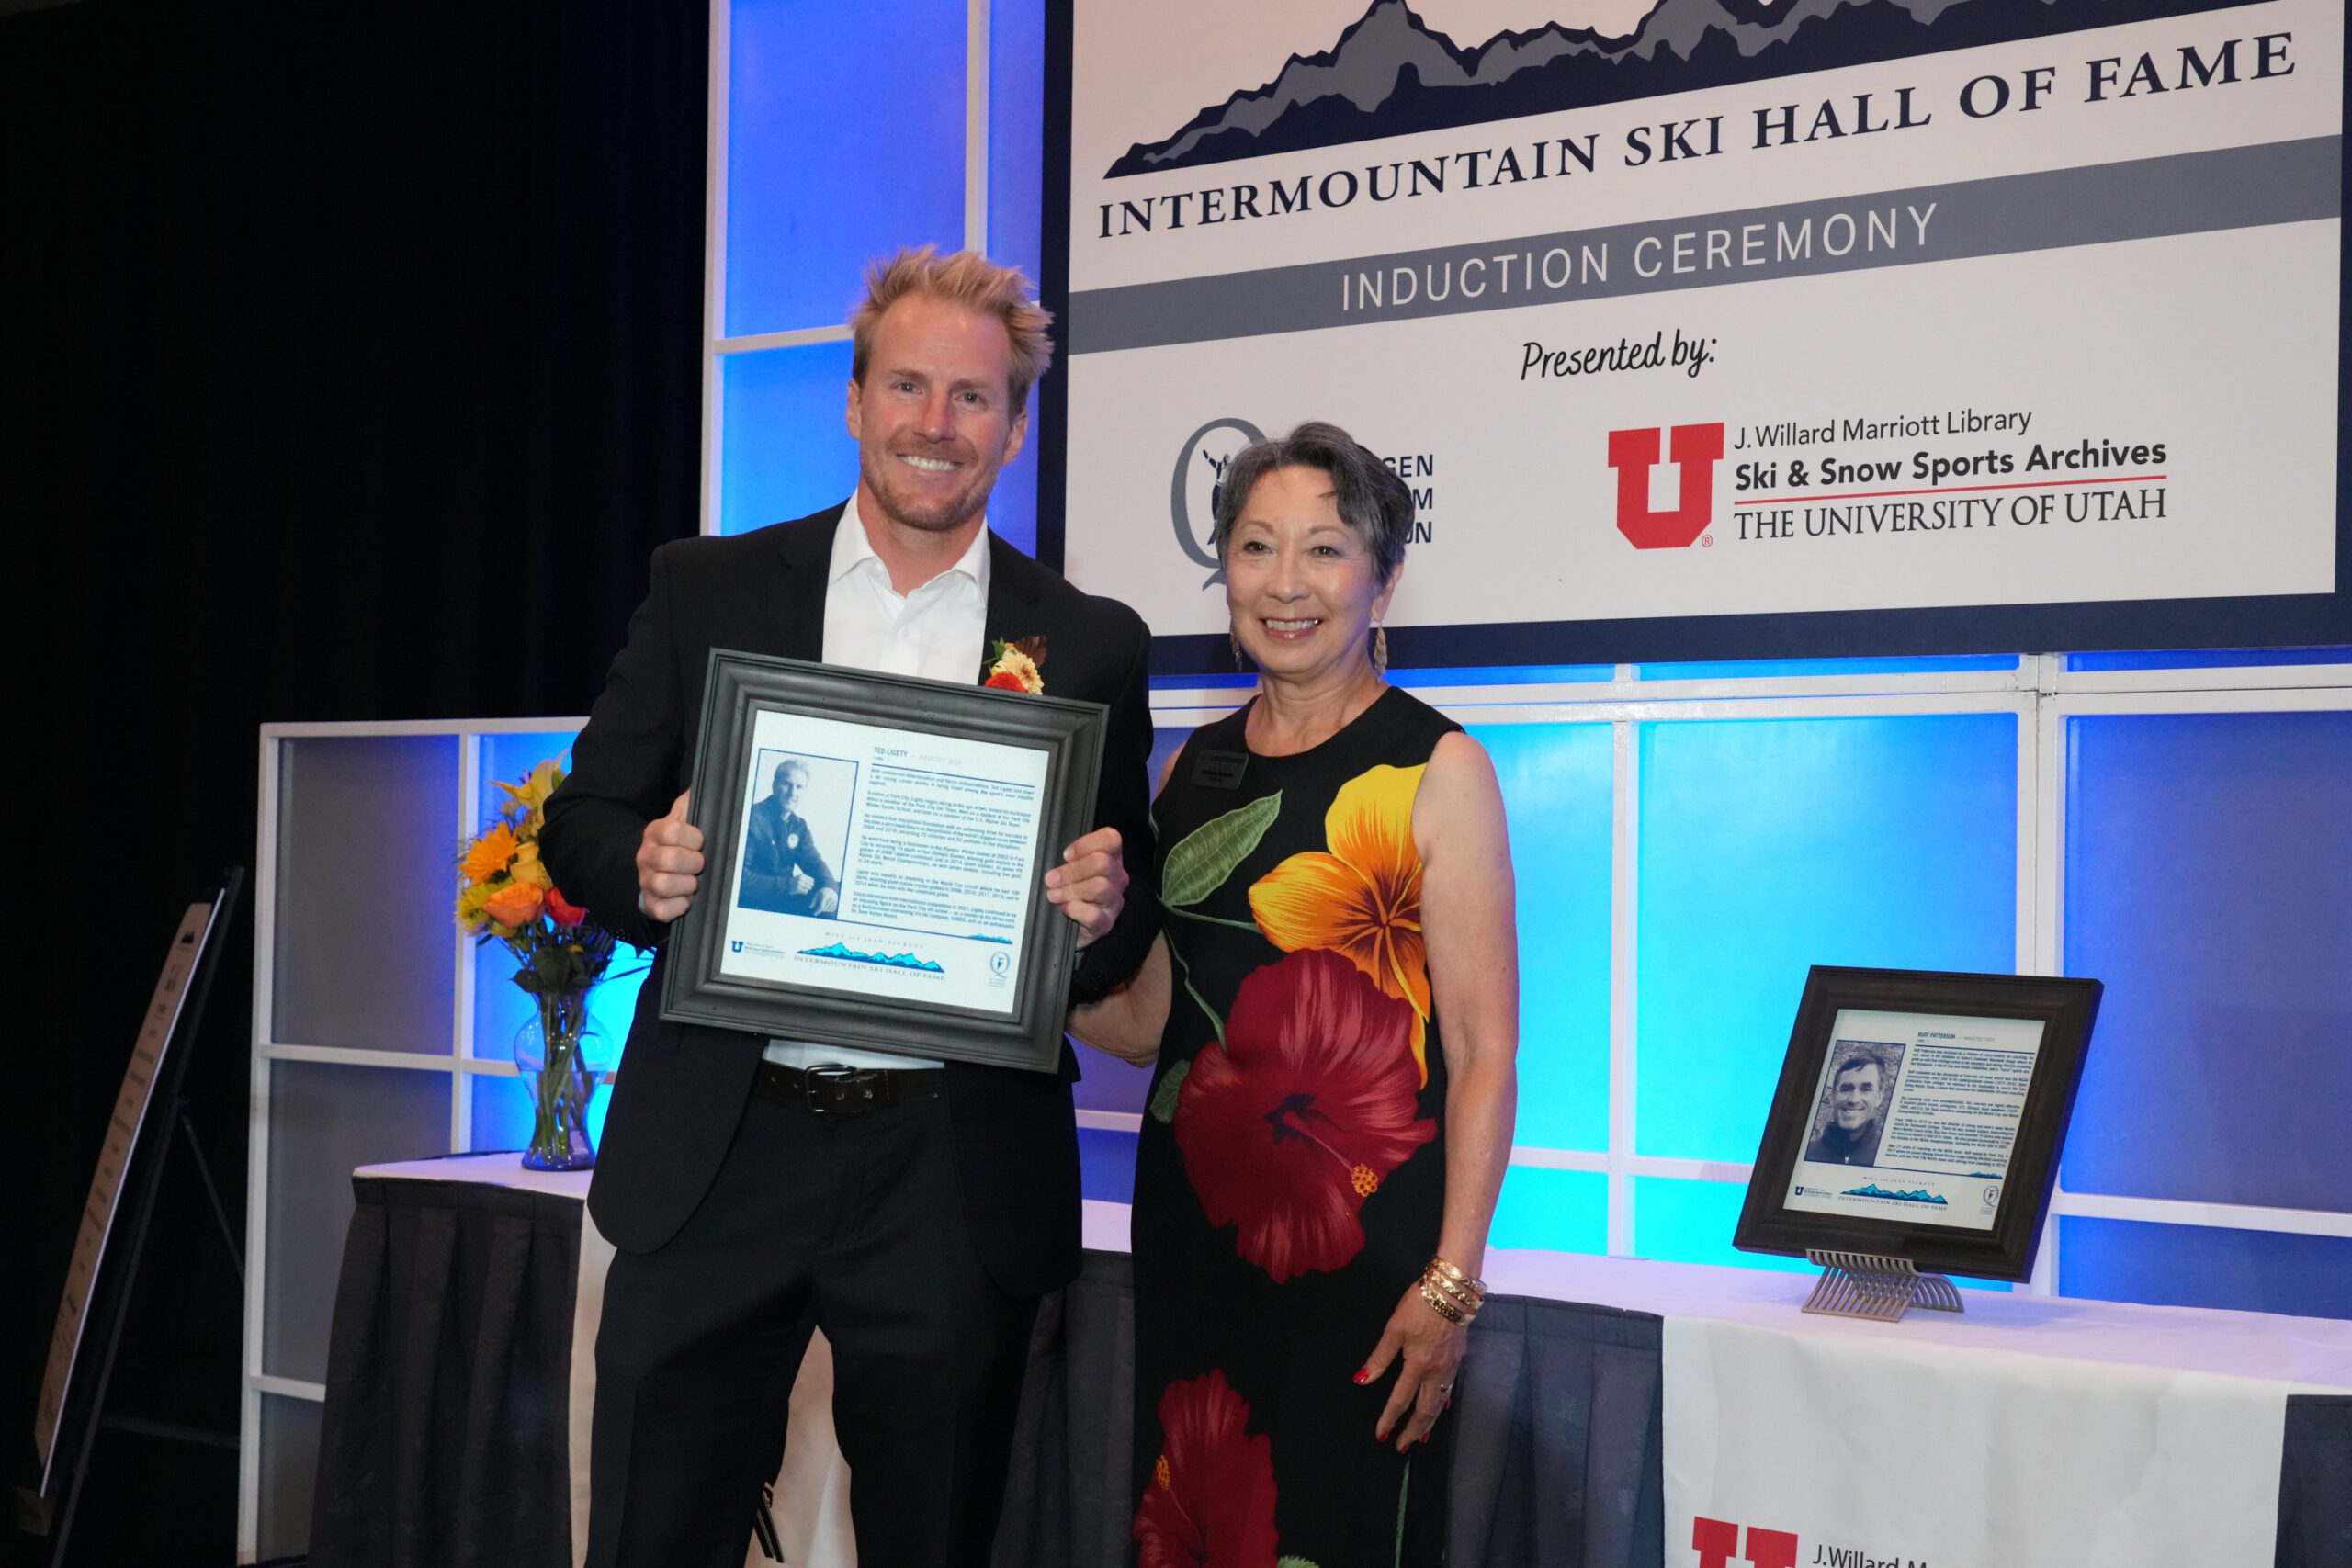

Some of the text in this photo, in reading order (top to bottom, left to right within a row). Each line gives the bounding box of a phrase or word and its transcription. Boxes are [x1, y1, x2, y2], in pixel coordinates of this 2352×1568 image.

[1098, 32, 2296, 239] INTERMOUNTAIN SKI HALL OF FAME
[1343, 203, 1937, 311] INDUCTION CEREMONY
[1521, 328, 1717, 380] Presented by:
[1842, 413, 1940, 442] Marriott
[1946, 409, 2032, 436] Library
[1734, 438, 2168, 491] Ski & Snow Sports Archives
[1734, 488, 2167, 541] THE UNIVERSITY OF UTAH
